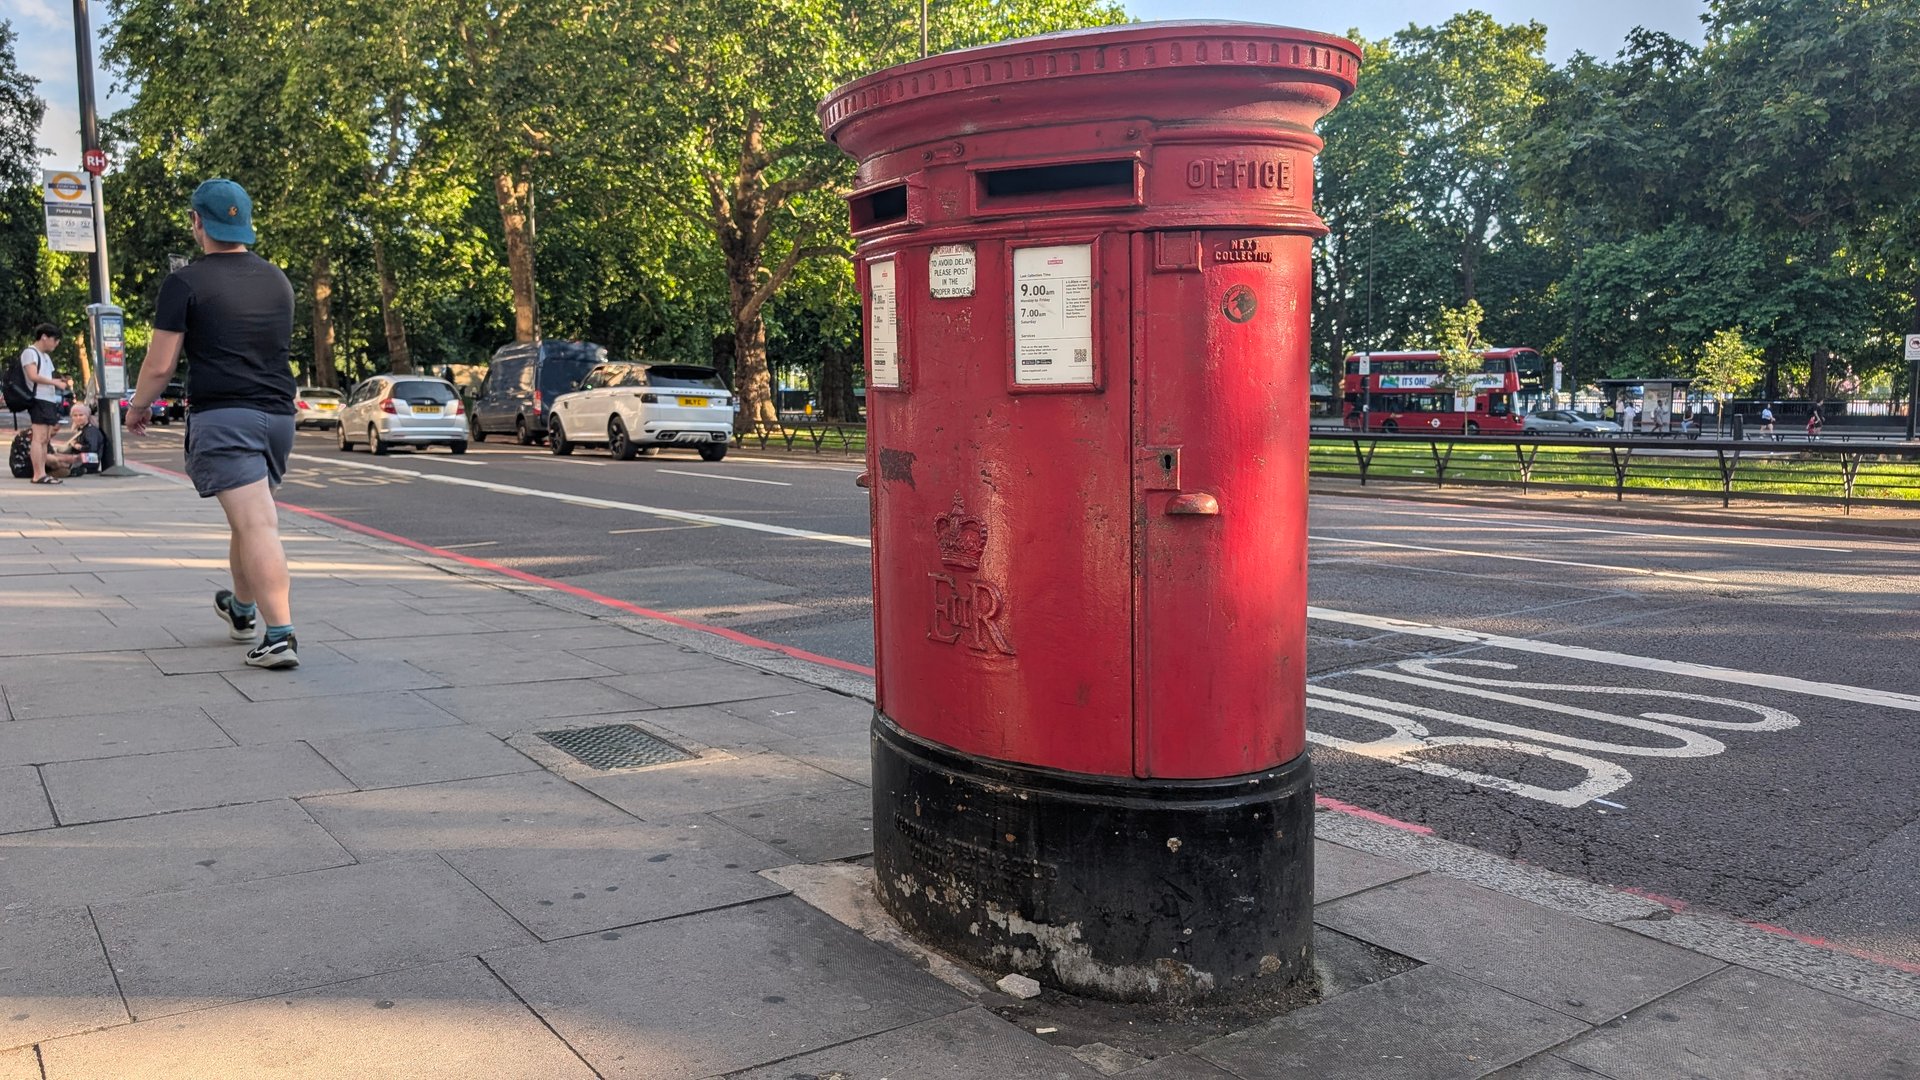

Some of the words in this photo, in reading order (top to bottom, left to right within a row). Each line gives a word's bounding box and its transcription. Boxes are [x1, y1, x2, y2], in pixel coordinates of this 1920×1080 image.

[86, 155, 106, 167] RH
[1186, 159, 1290, 190] OFFICE
[1230, 239, 1260, 250] NEXT
[938, 259, 953, 267] AVOID
[954, 257, 973, 266] DELAY
[934, 268, 952, 277] PLEASE
[953, 267, 969, 276] POST
[942, 278, 948, 286] IN
[949, 277, 959, 286] THE
[931, 287, 951, 296] PROPER
[951, 286, 971, 295] BOXES
[1020, 283, 1055, 297] 9.00am
[1020, 308, 1047, 318] 7.00am
[1402, 377, 1415, 386] IT'S
[1416, 376, 1427, 386] ON!
